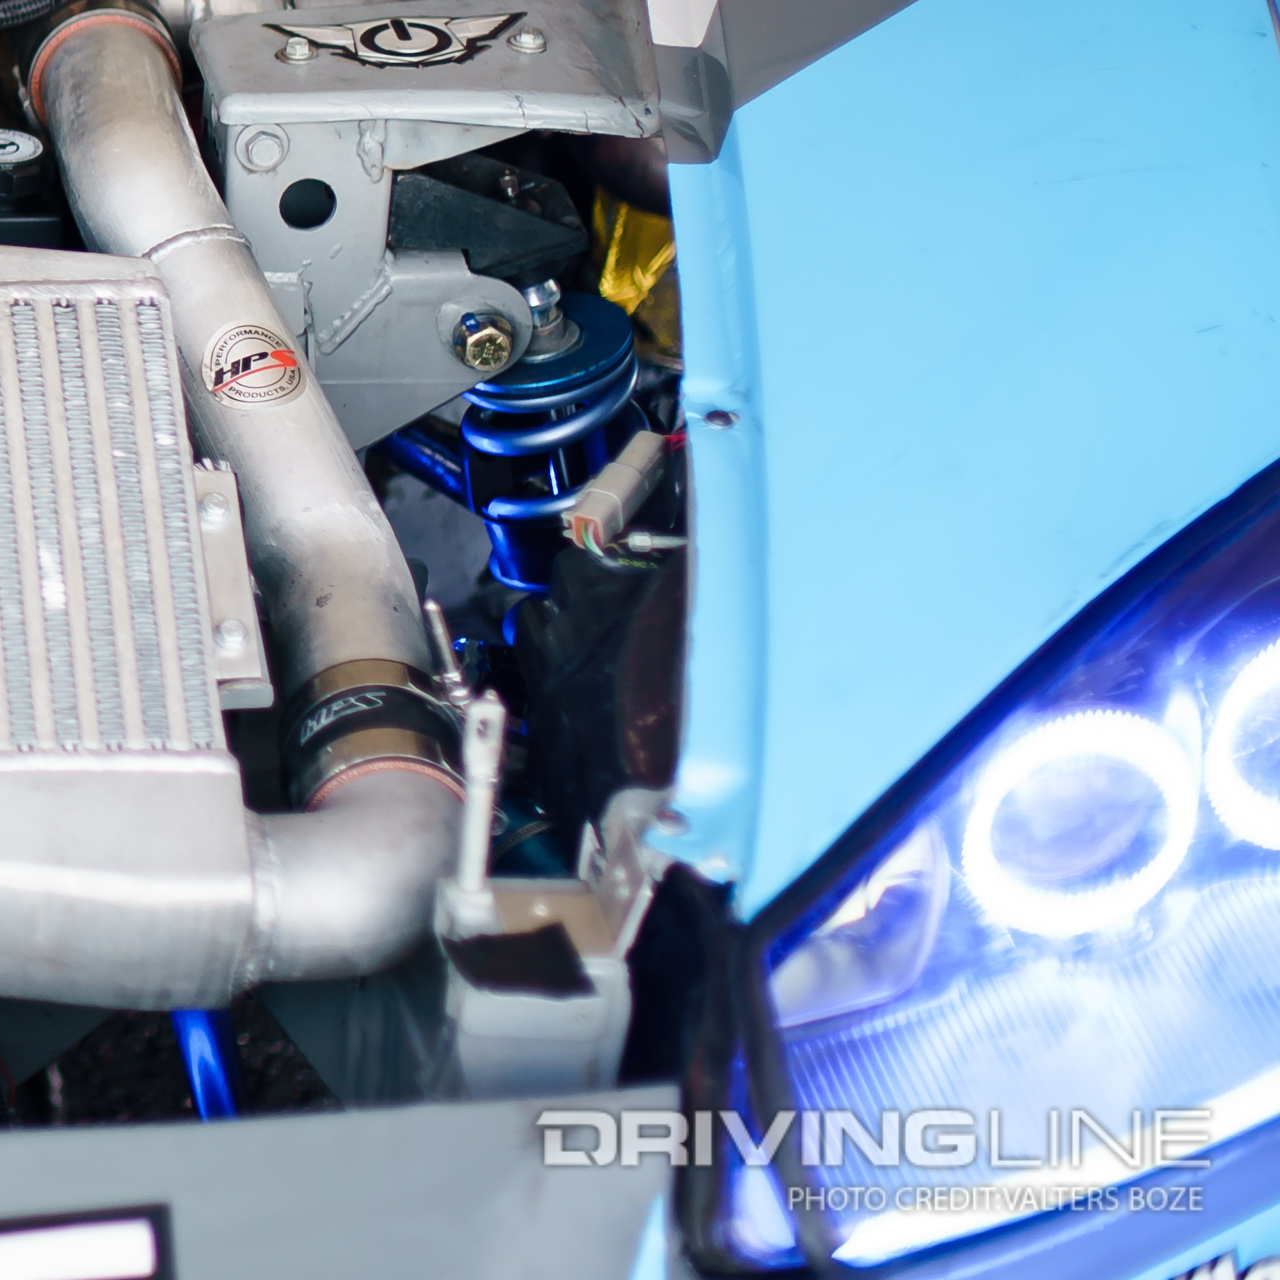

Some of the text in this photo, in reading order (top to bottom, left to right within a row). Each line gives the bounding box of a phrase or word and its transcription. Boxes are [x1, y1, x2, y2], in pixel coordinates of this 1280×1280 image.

[215, 329, 283, 367] PERFORMANCE
[213, 349, 298, 388] HPS
[286, 368, 297, 387] USA
[300, 691, 387, 747] HPS
